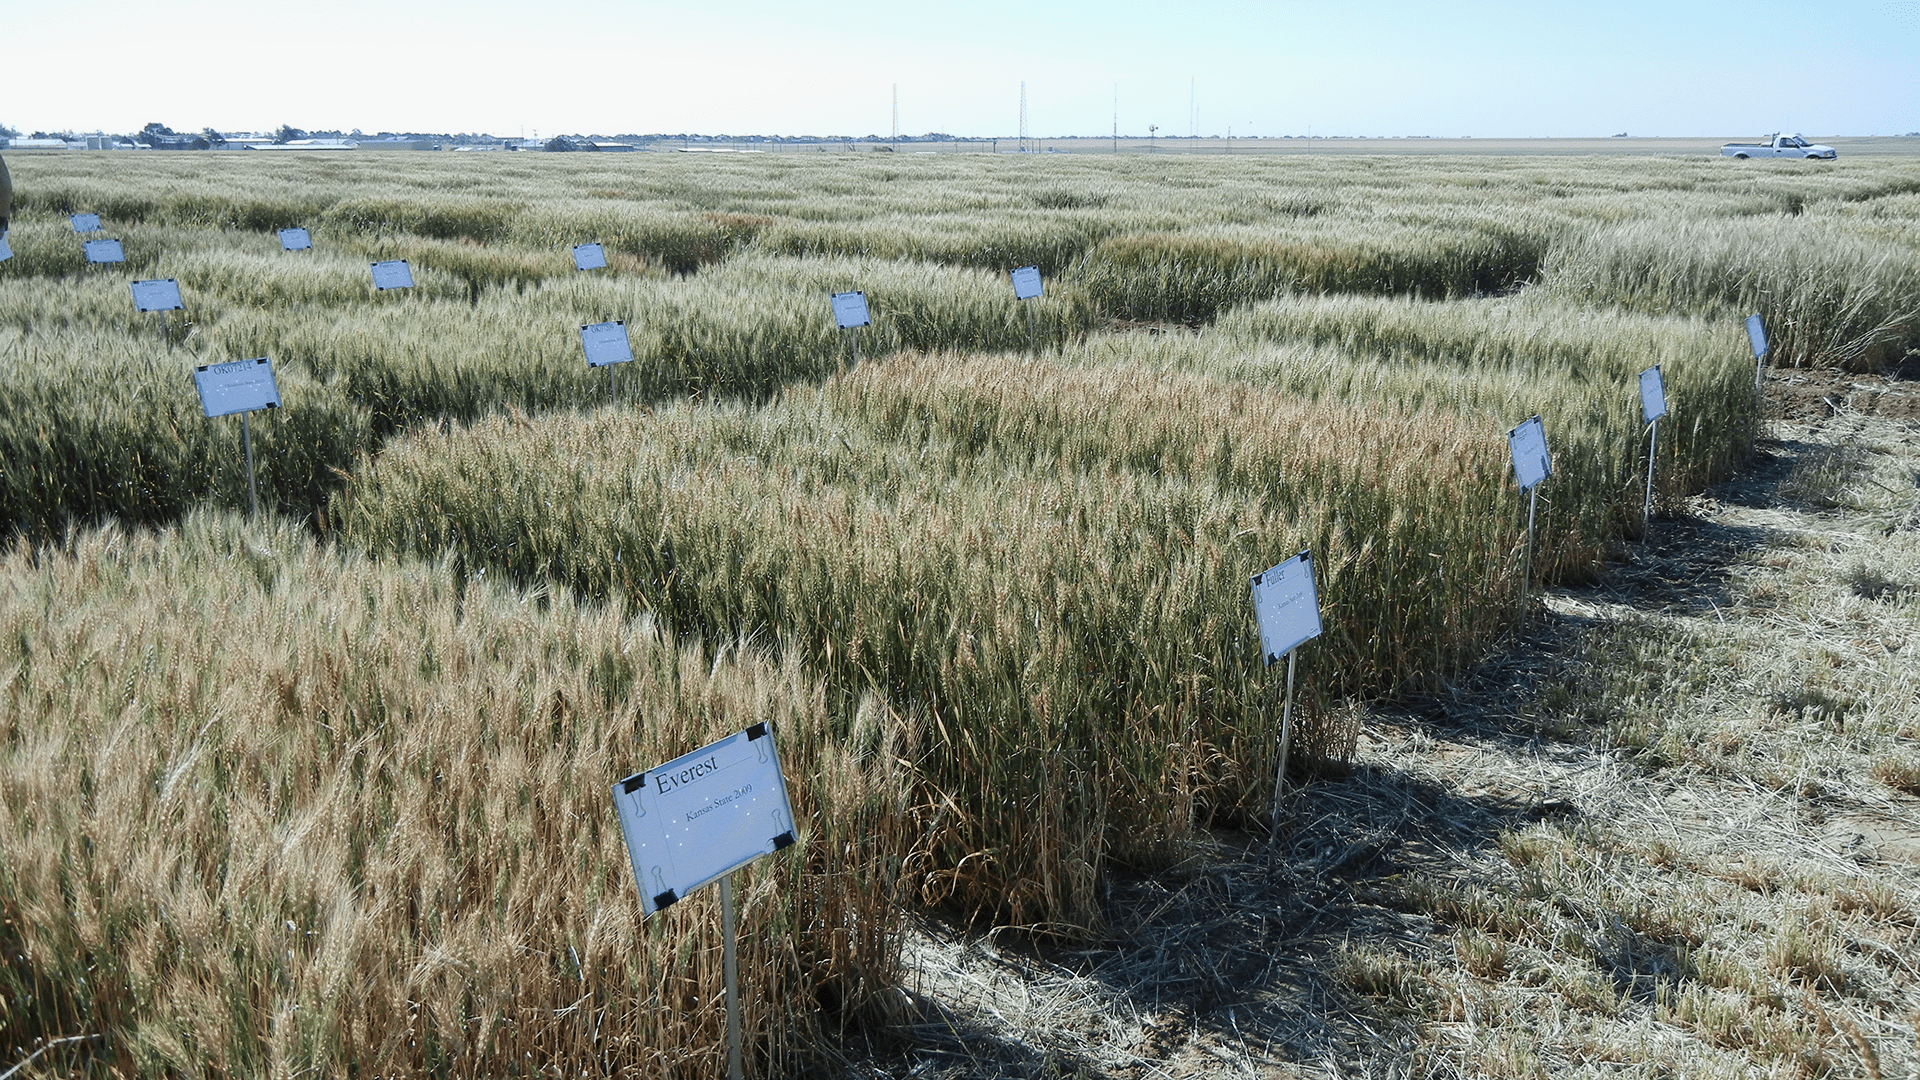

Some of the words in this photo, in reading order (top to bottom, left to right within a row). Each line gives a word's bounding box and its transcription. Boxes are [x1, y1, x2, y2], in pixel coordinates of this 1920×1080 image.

[1265, 569, 1285, 588] Fuller
[655, 754, 719, 795] Everest
[686, 804, 713, 822] Kansas
[713, 795, 733, 809] State
[733, 783, 753, 800] 2009
